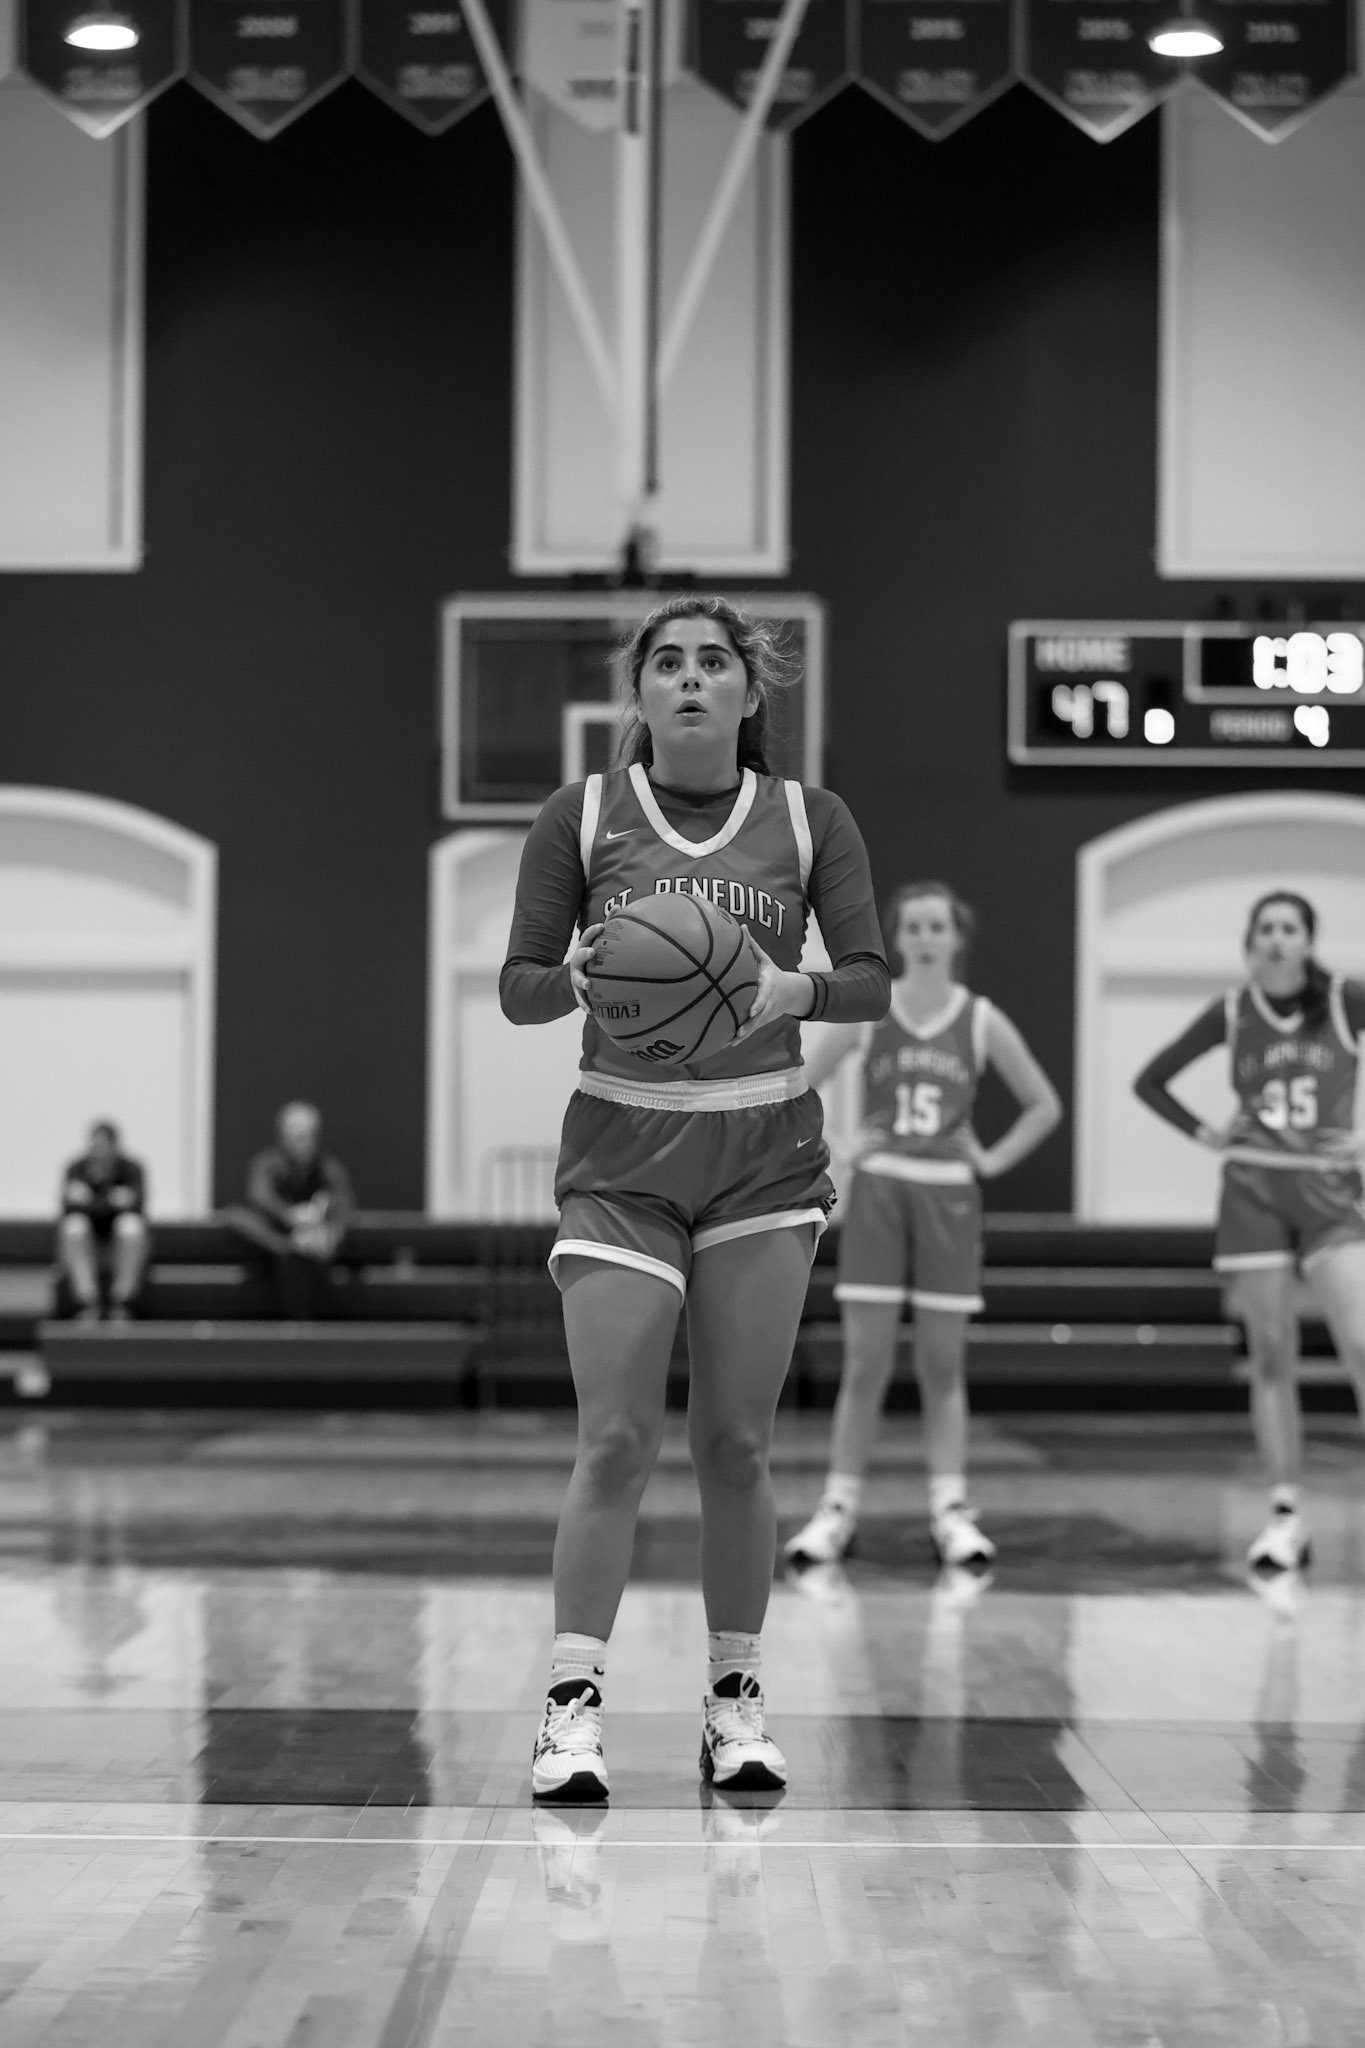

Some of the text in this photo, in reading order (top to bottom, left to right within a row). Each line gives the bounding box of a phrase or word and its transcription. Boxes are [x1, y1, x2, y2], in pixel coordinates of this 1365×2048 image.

[1053, 681, 1129, 738] 47
[893, 1082, 943, 1136] 15
[1259, 1076, 1318, 1131] 35
